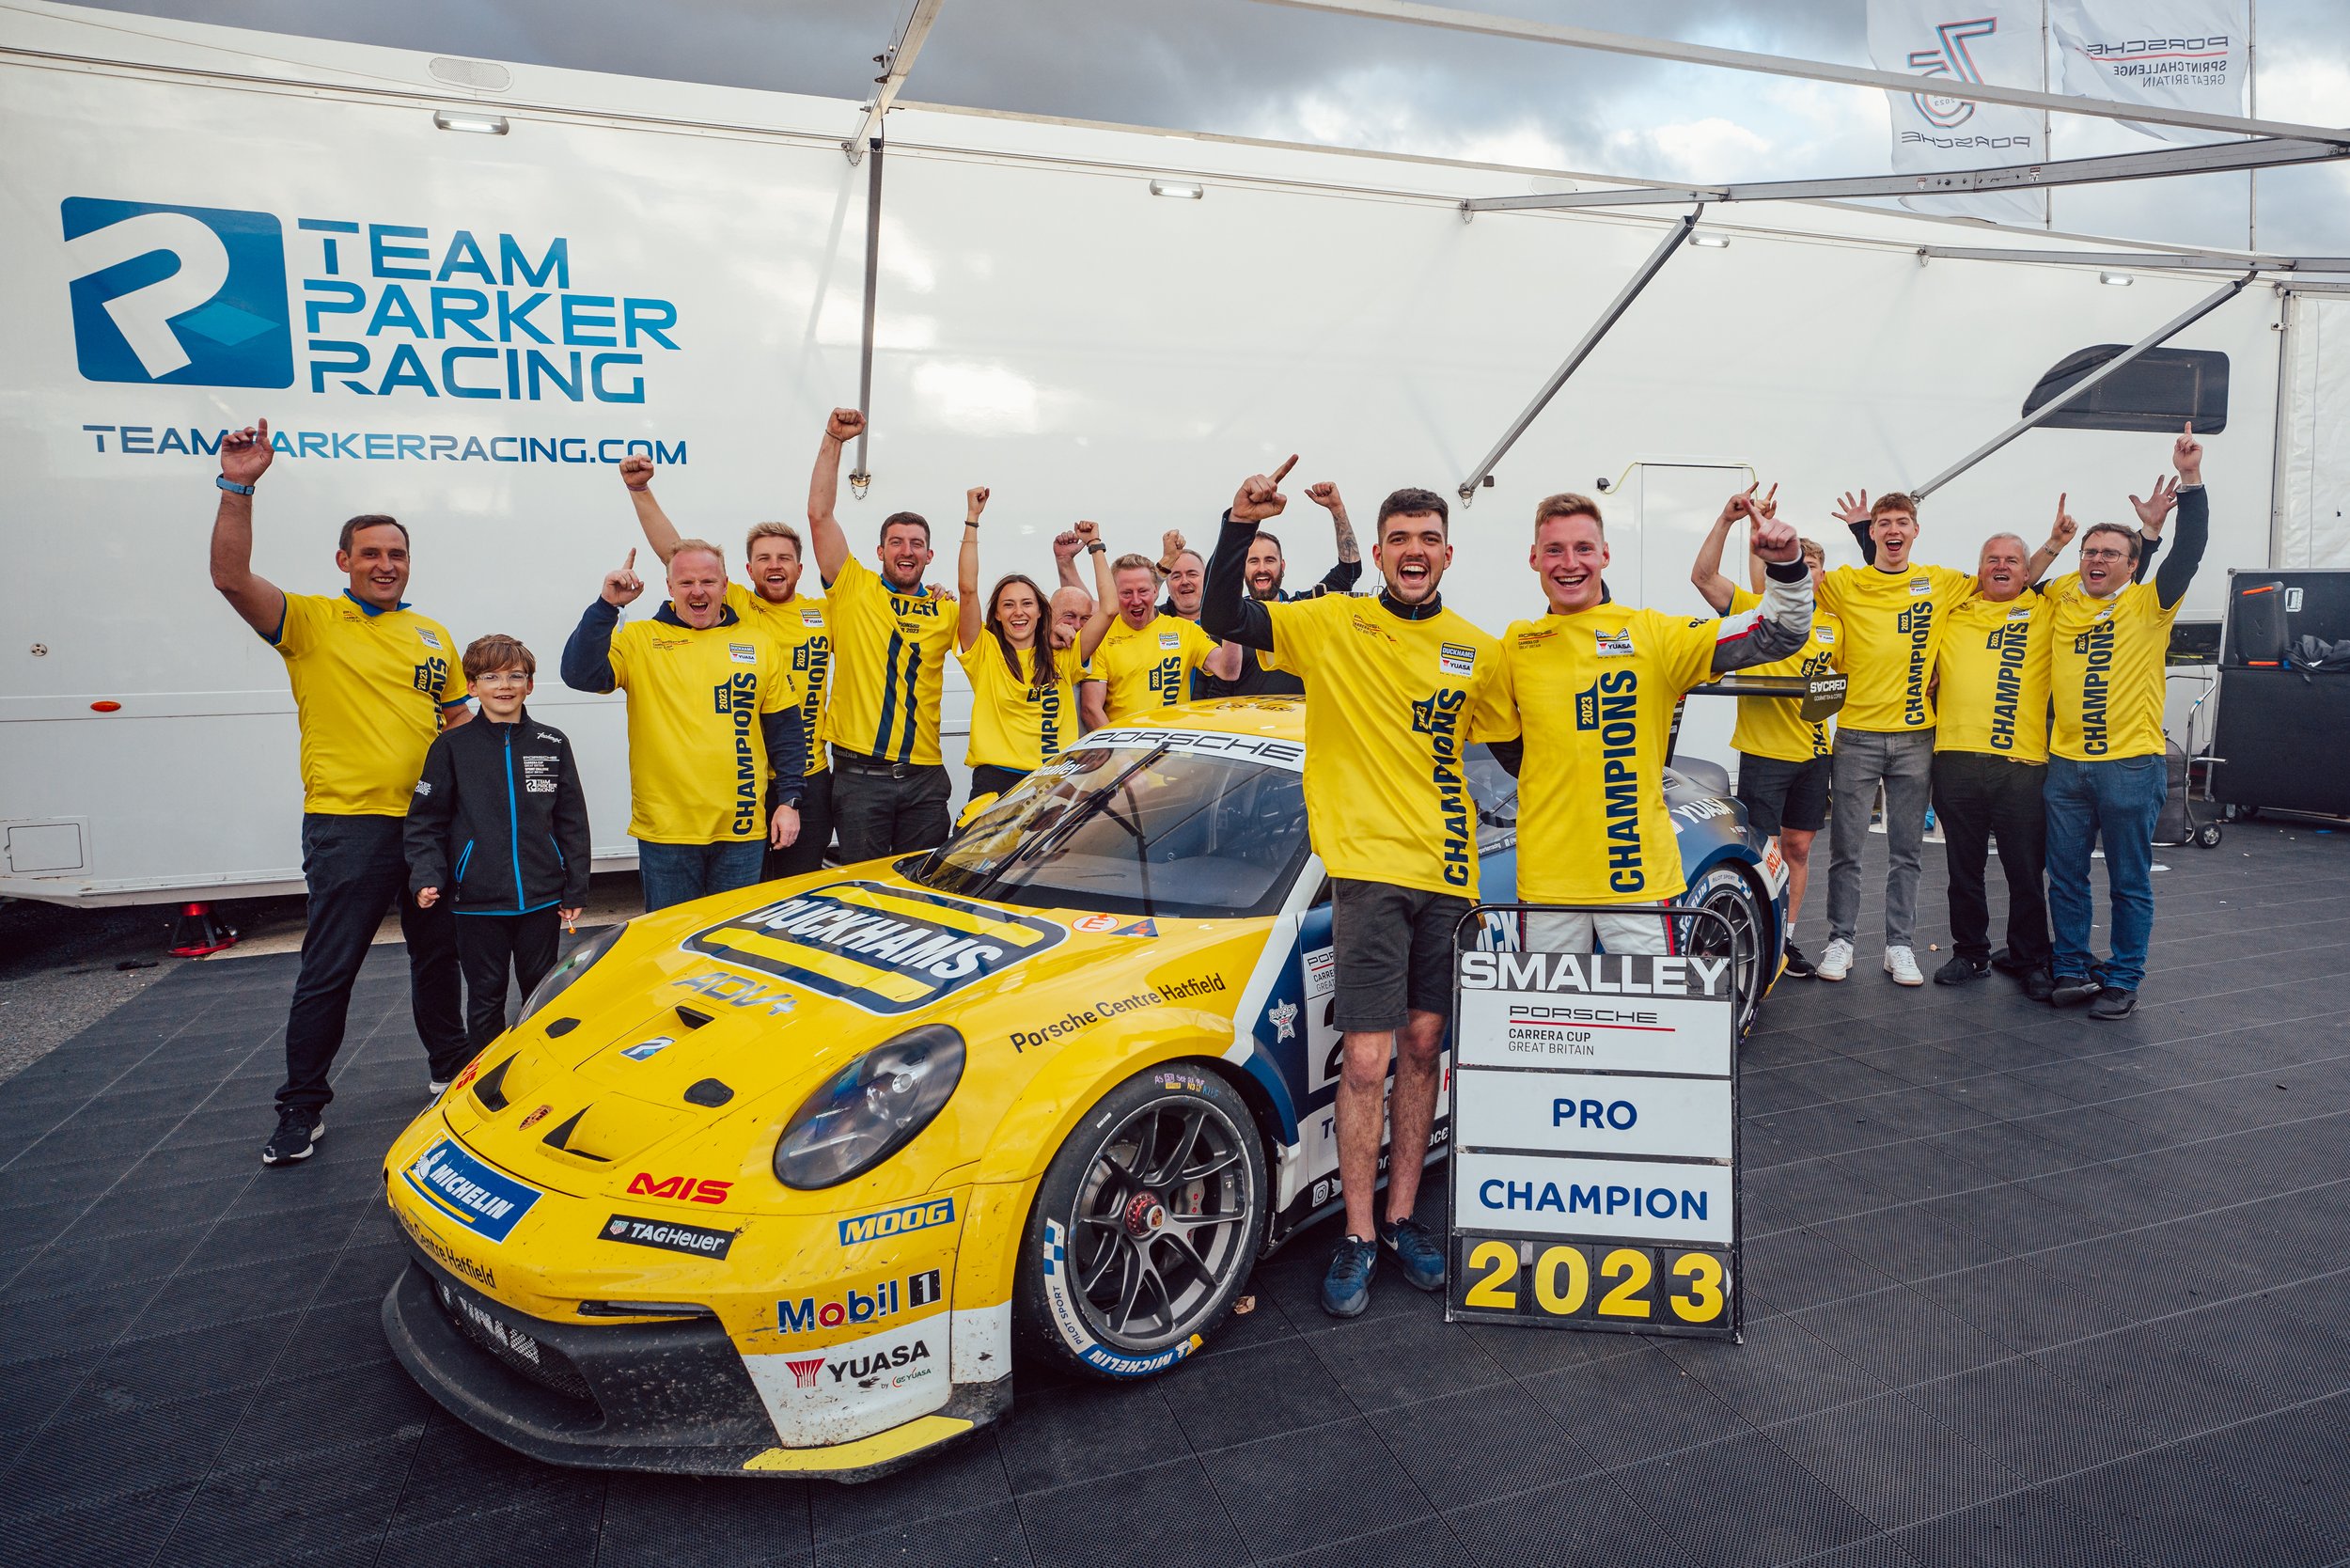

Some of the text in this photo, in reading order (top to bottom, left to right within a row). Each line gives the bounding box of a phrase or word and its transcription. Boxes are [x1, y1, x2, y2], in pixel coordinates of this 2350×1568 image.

[298, 218, 570, 289] TEAM
[303, 279, 682, 351] PARKER
[307, 339, 646, 404] RACING
[83, 424, 687, 465] TEAMARKERRACING.COM
[796, 649, 807, 667] 2023
[1442, 646, 1474, 659] DUCKHAMS
[1449, 662, 1471, 671] YUASA
[1904, 601, 1934, 726] CHAMPIONS
[417, 668, 428, 690] 2023
[718, 688, 728, 710] 2023
[1989, 621, 2029, 750] CHAMPIONS
[2081, 619, 2114, 756] CHAMPIONS
[1581, 696, 1594, 725] 2023
[732, 671, 758, 836] CHAMPIONS
[1085, 731, 1304, 762] PORSCHE
[1431, 687, 1470, 886] CHAMPIONS
[1600, 669, 1646, 893] CHAMPIONS
[1670, 797, 1735, 824] YUASA
[741, 898, 1003, 980] DUCKHAMS
[1313, 968, 1335, 983] CARRE
[1460, 951, 1730, 996] SMALLEY
[1010, 972, 1227, 1054] Porsche Centre Hatfield
[1510, 1005, 1658, 1025] PORSCHE
[1508, 1041, 1594, 1056] GREAT BRITAIN
[1509, 1028, 1591, 1043] CARRERA CUP
[1552, 1098, 1637, 1131] PRO
[429, 1163, 516, 1220] MICHELIN
[626, 1171, 735, 1205] MIS
[1479, 1179, 1708, 1221] CHAMPION
[844, 1201, 952, 1244] MOOG
[413, 1222, 497, 1289] Centre Hatfield
[1465, 1240, 1724, 1324] 2023
[776, 1278, 899, 1335] Mobil
[1052, 1285, 1084, 1345] PILOT SPORT
[826, 1340, 932, 1383] YUASA
[1088, 1348, 1174, 1373] MICHELIN
